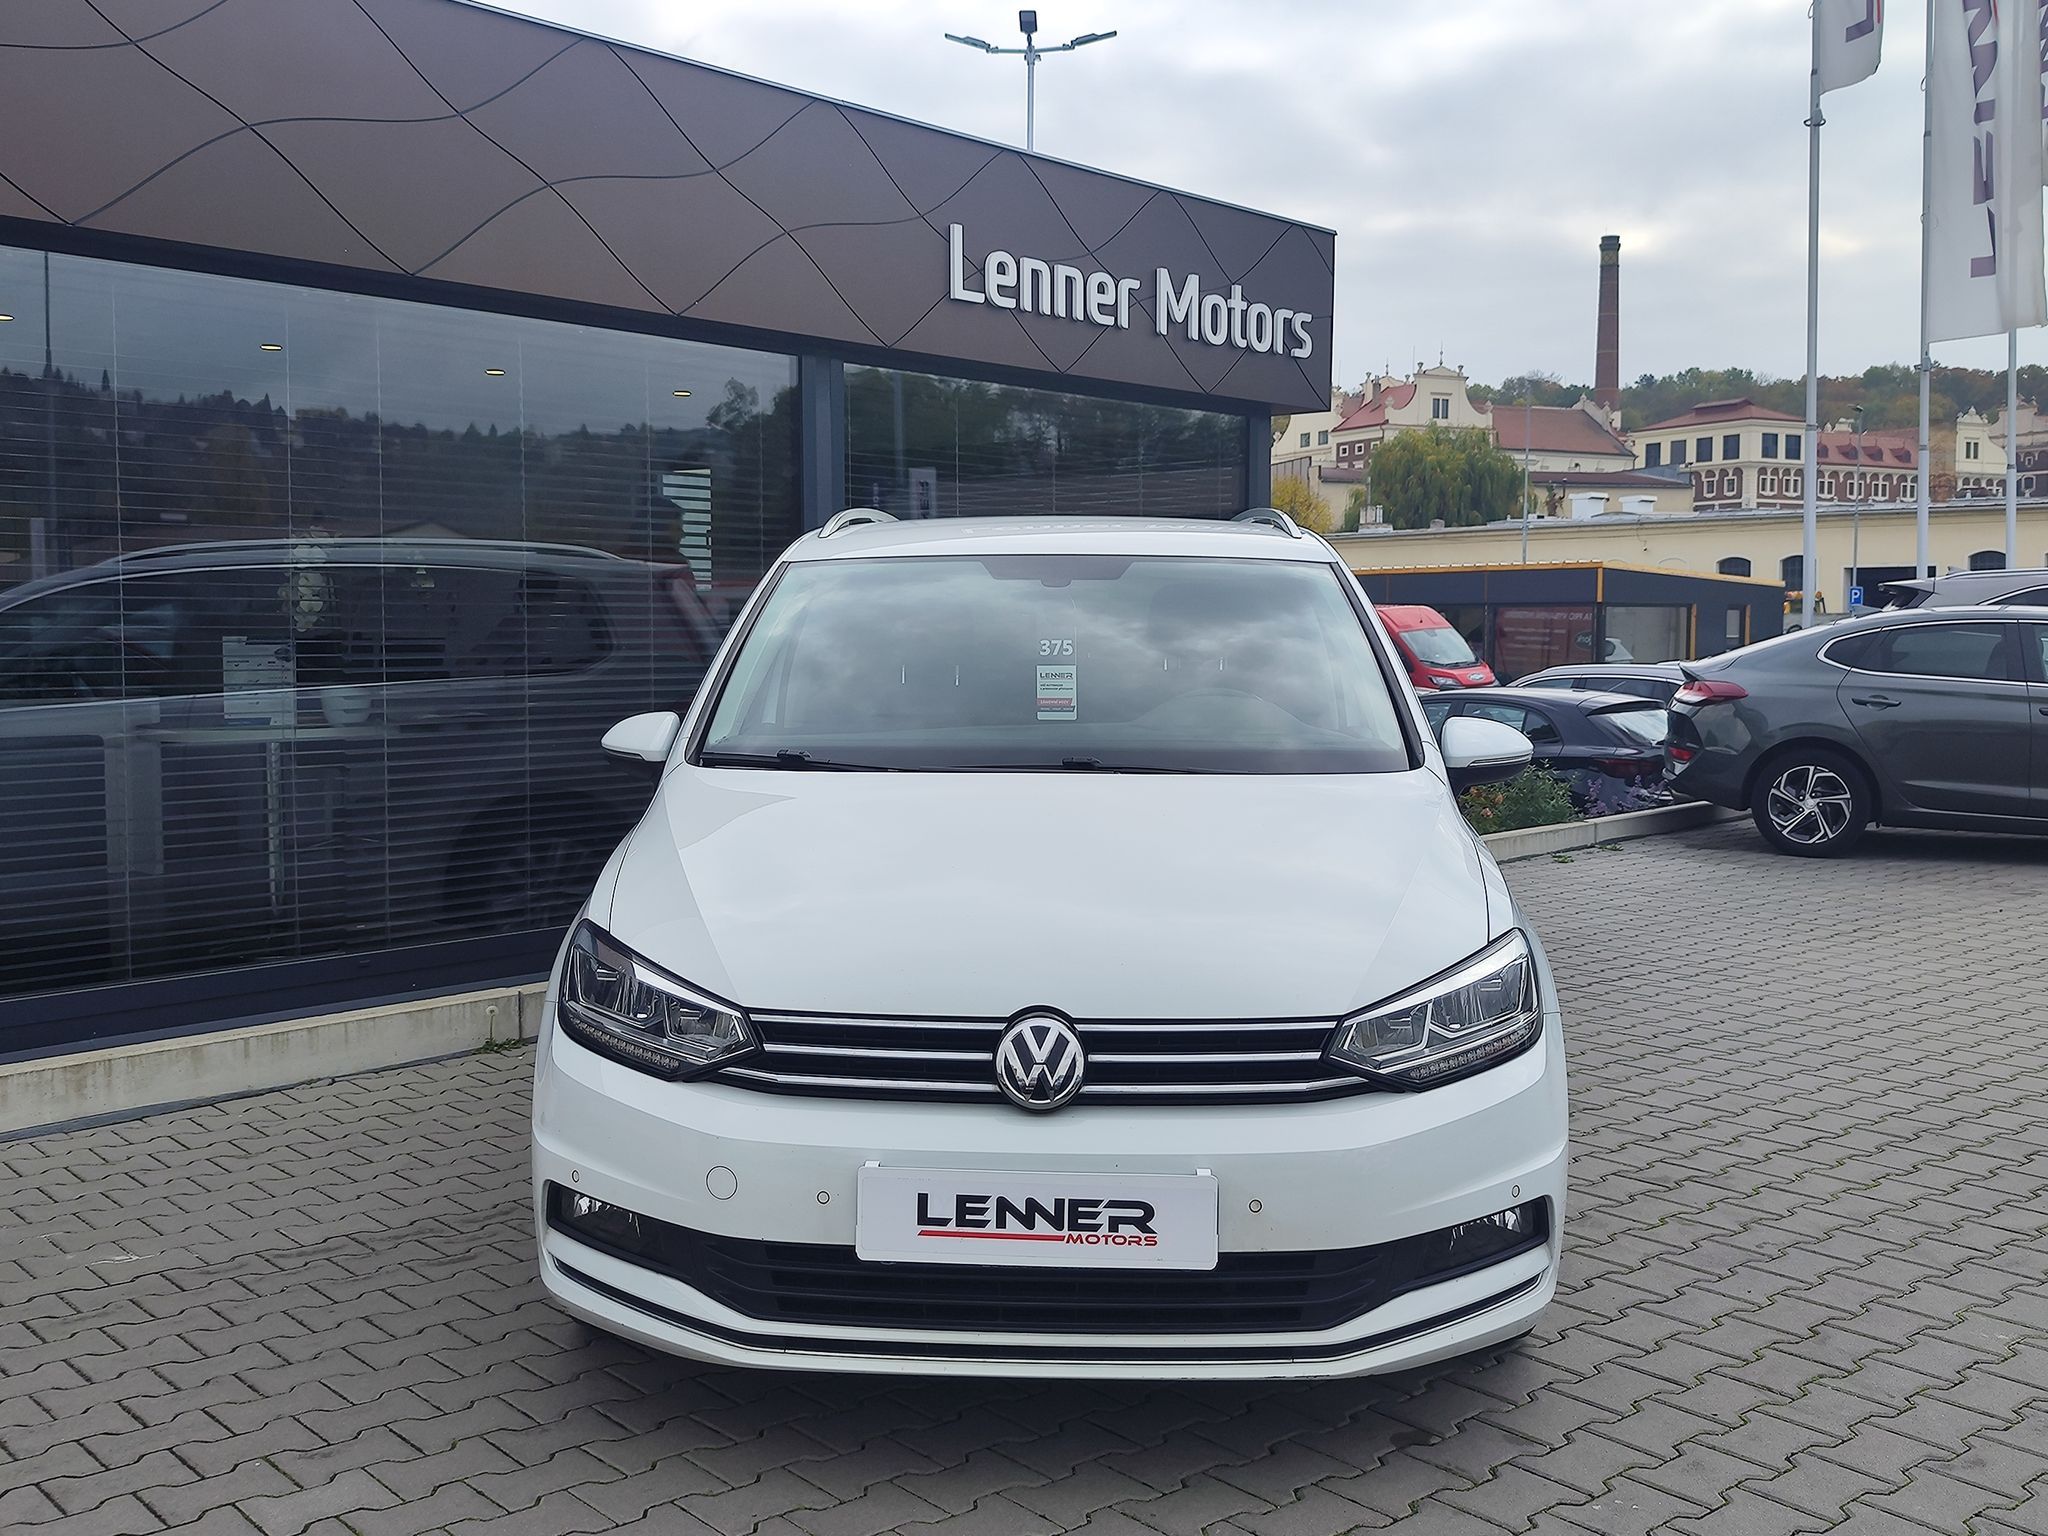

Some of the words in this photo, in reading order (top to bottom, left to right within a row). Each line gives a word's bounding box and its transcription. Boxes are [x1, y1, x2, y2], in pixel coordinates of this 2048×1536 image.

[949, 222, 1140, 329] Lenner
[1156, 267, 1313, 359] Motors
[1851, 589, 1860, 603] P
[1039, 639, 1074, 656] 375
[916, 1192, 1158, 1235] LENNER
[1065, 1233, 1158, 1247] MOTORS
